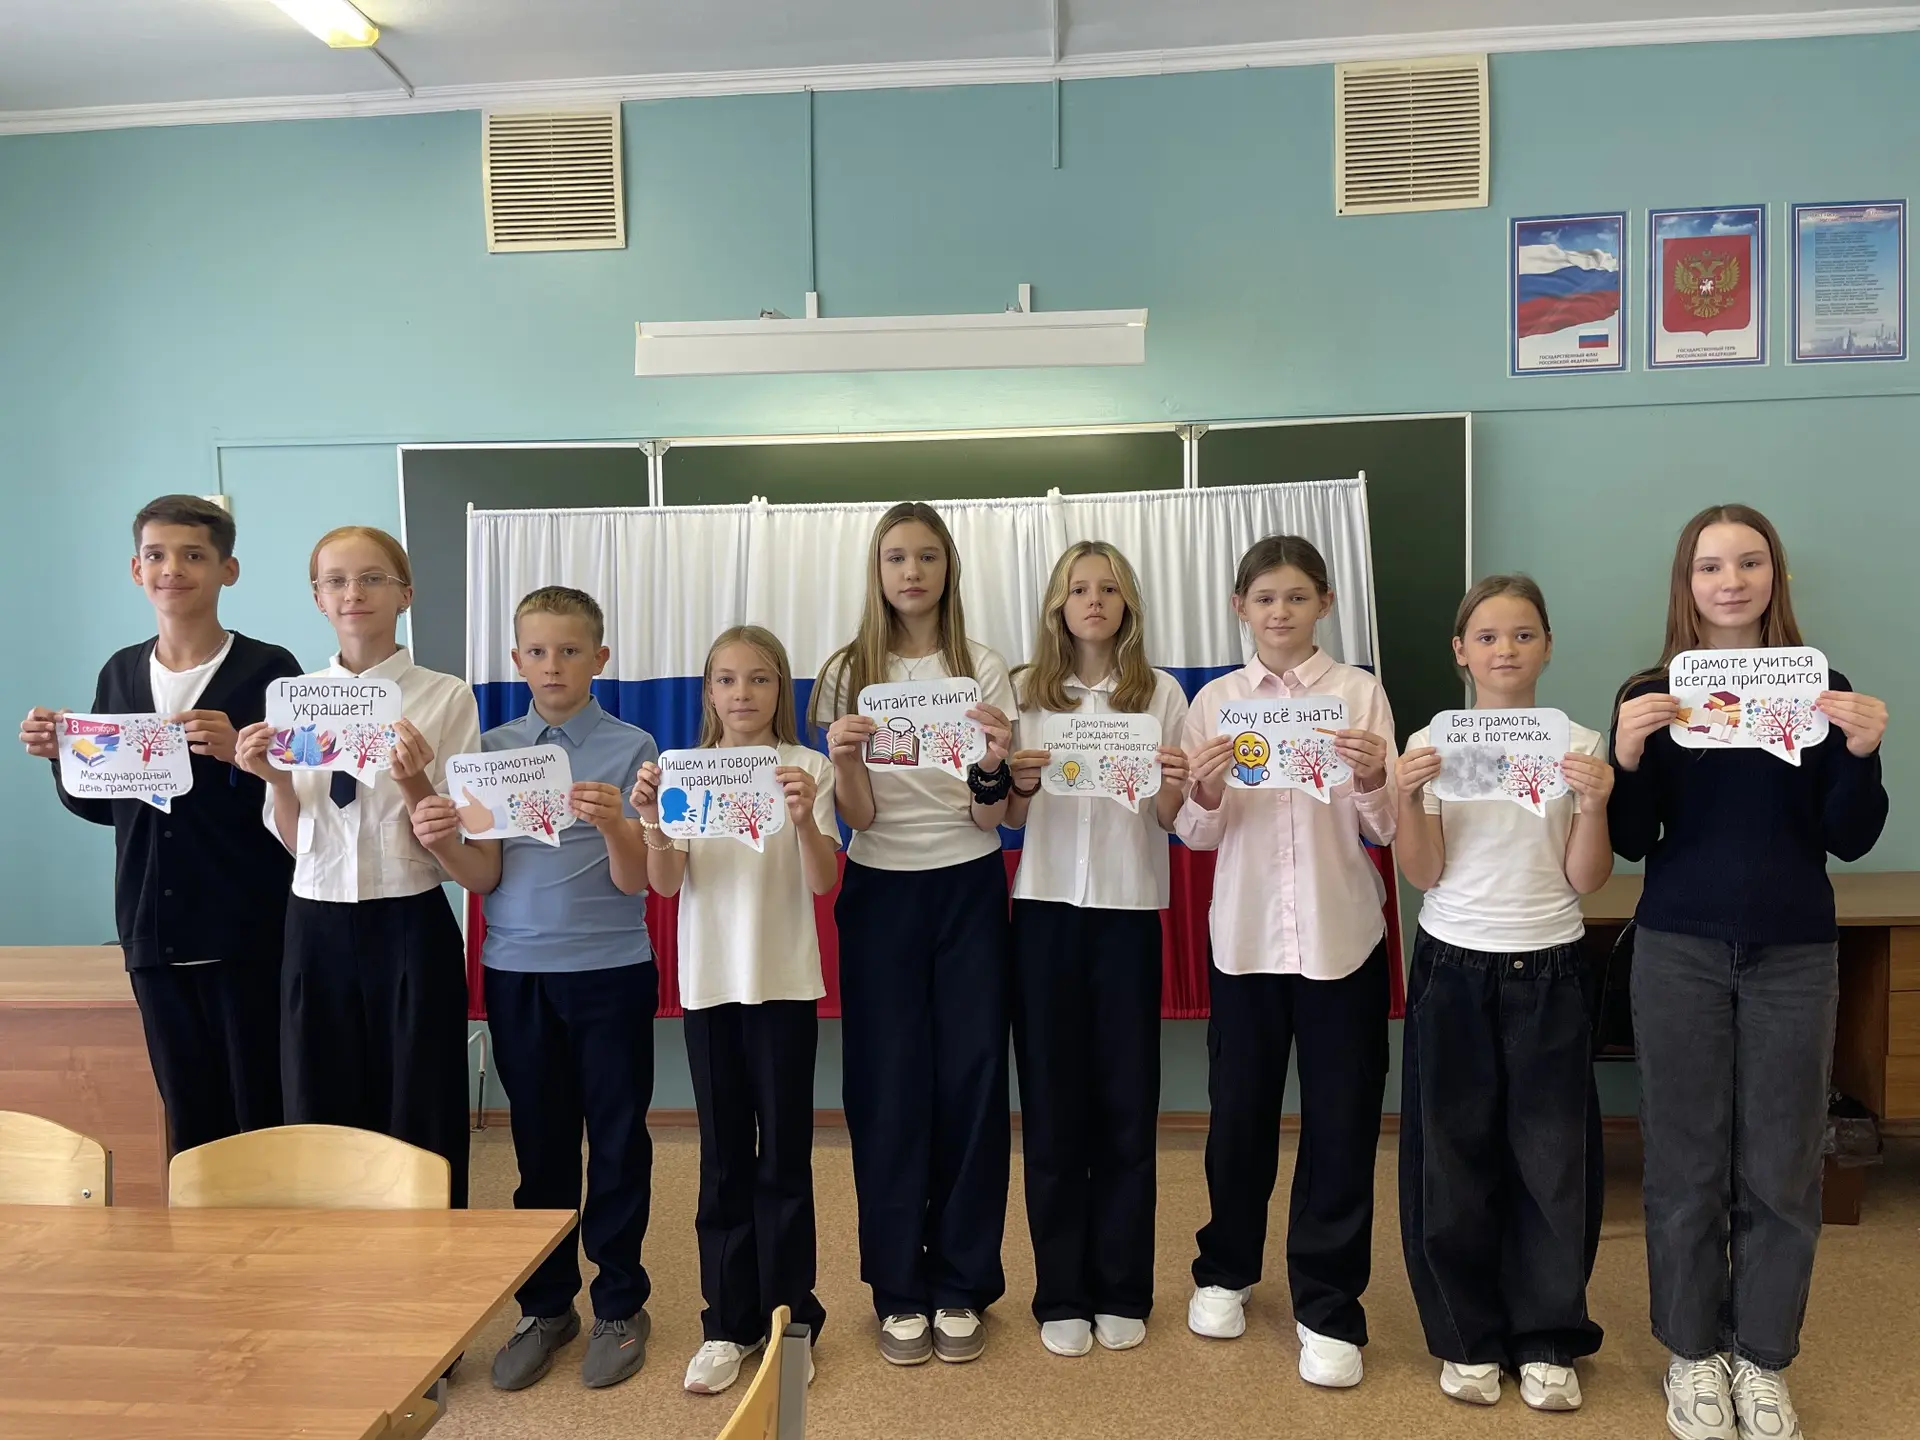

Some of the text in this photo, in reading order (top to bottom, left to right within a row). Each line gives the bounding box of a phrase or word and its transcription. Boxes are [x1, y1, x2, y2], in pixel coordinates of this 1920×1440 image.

[1683, 655, 1814, 674] Грамоте учиться
[1675, 672, 1822, 690] всегда пригодится
[280, 681, 388, 703] Грамотность
[864, 687, 979, 711] Читайте книги!
[292, 700, 374, 721] украшает!
[1219, 703, 1343, 729] Хочу всё знать!
[71, 720, 116, 735] 8 сентября
[1070, 718, 1129, 731] Грамотными
[1451, 714, 1541, 731] Без грамоты,
[1076, 731, 1129, 741] рождаются
[1446, 731, 1551, 743] как в потемках.
[1043, 741, 1159, 752] грамотными становятся!
[453, 754, 556, 775] Быть грамотным
[661, 756, 778, 771] Пишем и говорим
[80, 770, 172, 783] Международный
[477, 777, 497, 787] это
[501, 767, 546, 785] модно!
[681, 770, 753, 791] правильно!
[79, 783, 102, 793] день
[105, 783, 177, 795] грамотности
